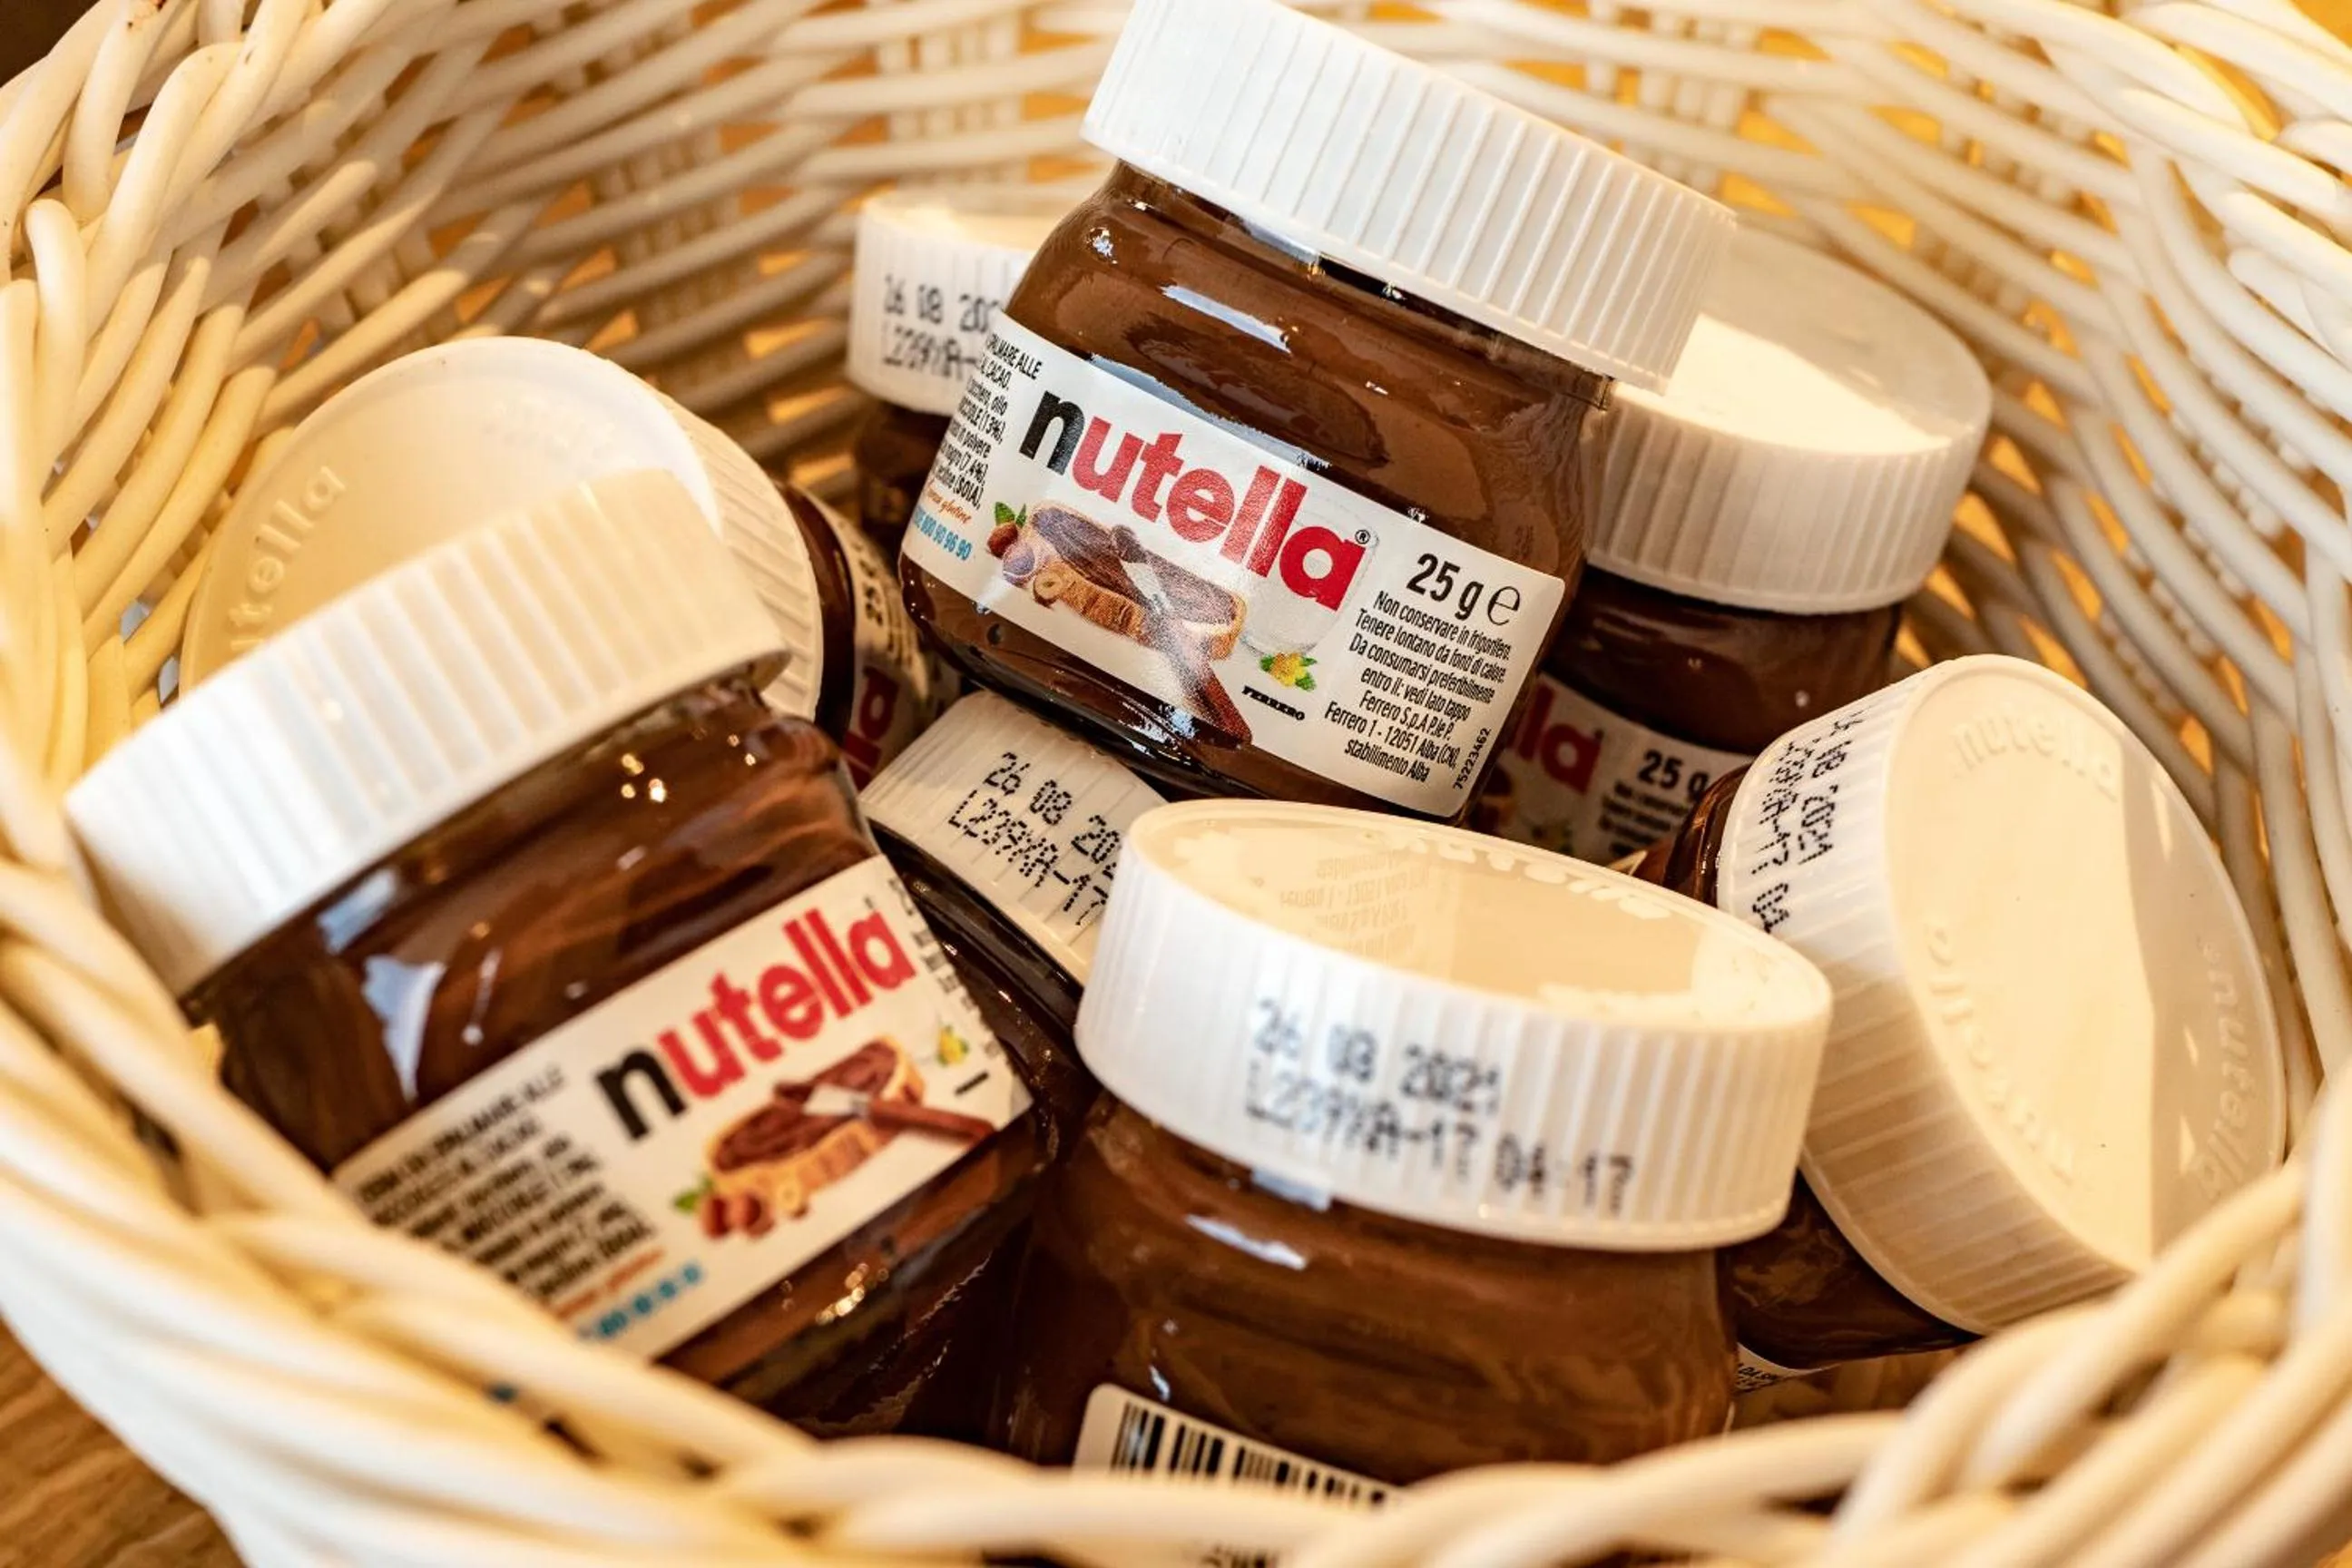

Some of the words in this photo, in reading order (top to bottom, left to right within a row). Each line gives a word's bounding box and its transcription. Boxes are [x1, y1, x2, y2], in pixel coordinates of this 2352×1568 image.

[1014, 353, 1042, 380] ALLE
[954, 475, 984, 509] (SOIA),
[1019, 389, 1367, 612] nutella
[956, 540, 972, 560] 90
[1406, 553, 1461, 603] 25
[1454, 581, 1485, 621] g
[1356, 609, 1395, 641] Tenere
[1394, 626, 1436, 657] lontano
[1435, 644, 1450, 663] da
[1374, 591, 1399, 616] Non
[1399, 605, 1458, 641] conservare
[1456, 626, 1469, 645] in
[1349, 633, 1367, 655] Da
[1367, 644, 1432, 681] consumarsi
[1359, 690, 1400, 720] Ferrero
[1444, 723, 1454, 740] P.
[1361, 668, 1392, 691] entro
[1390, 678, 1404, 697] il:
[1404, 685, 1428, 705] vedi
[1425, 692, 1446, 712] lato
[1445, 699, 1471, 723] tappo
[1325, 701, 1367, 733] Ferrero
[1368, 720, 1377, 737] 1
[1385, 726, 1419, 752] 12051
[1345, 740, 1408, 775] stabilimento
[1452, 729, 1491, 789] 75223462
[1637, 750, 1683, 789] 25
[982, 751, 1031, 797] 26
[1029, 779, 1073, 826] 08
[594, 907, 917, 1142] nutella
